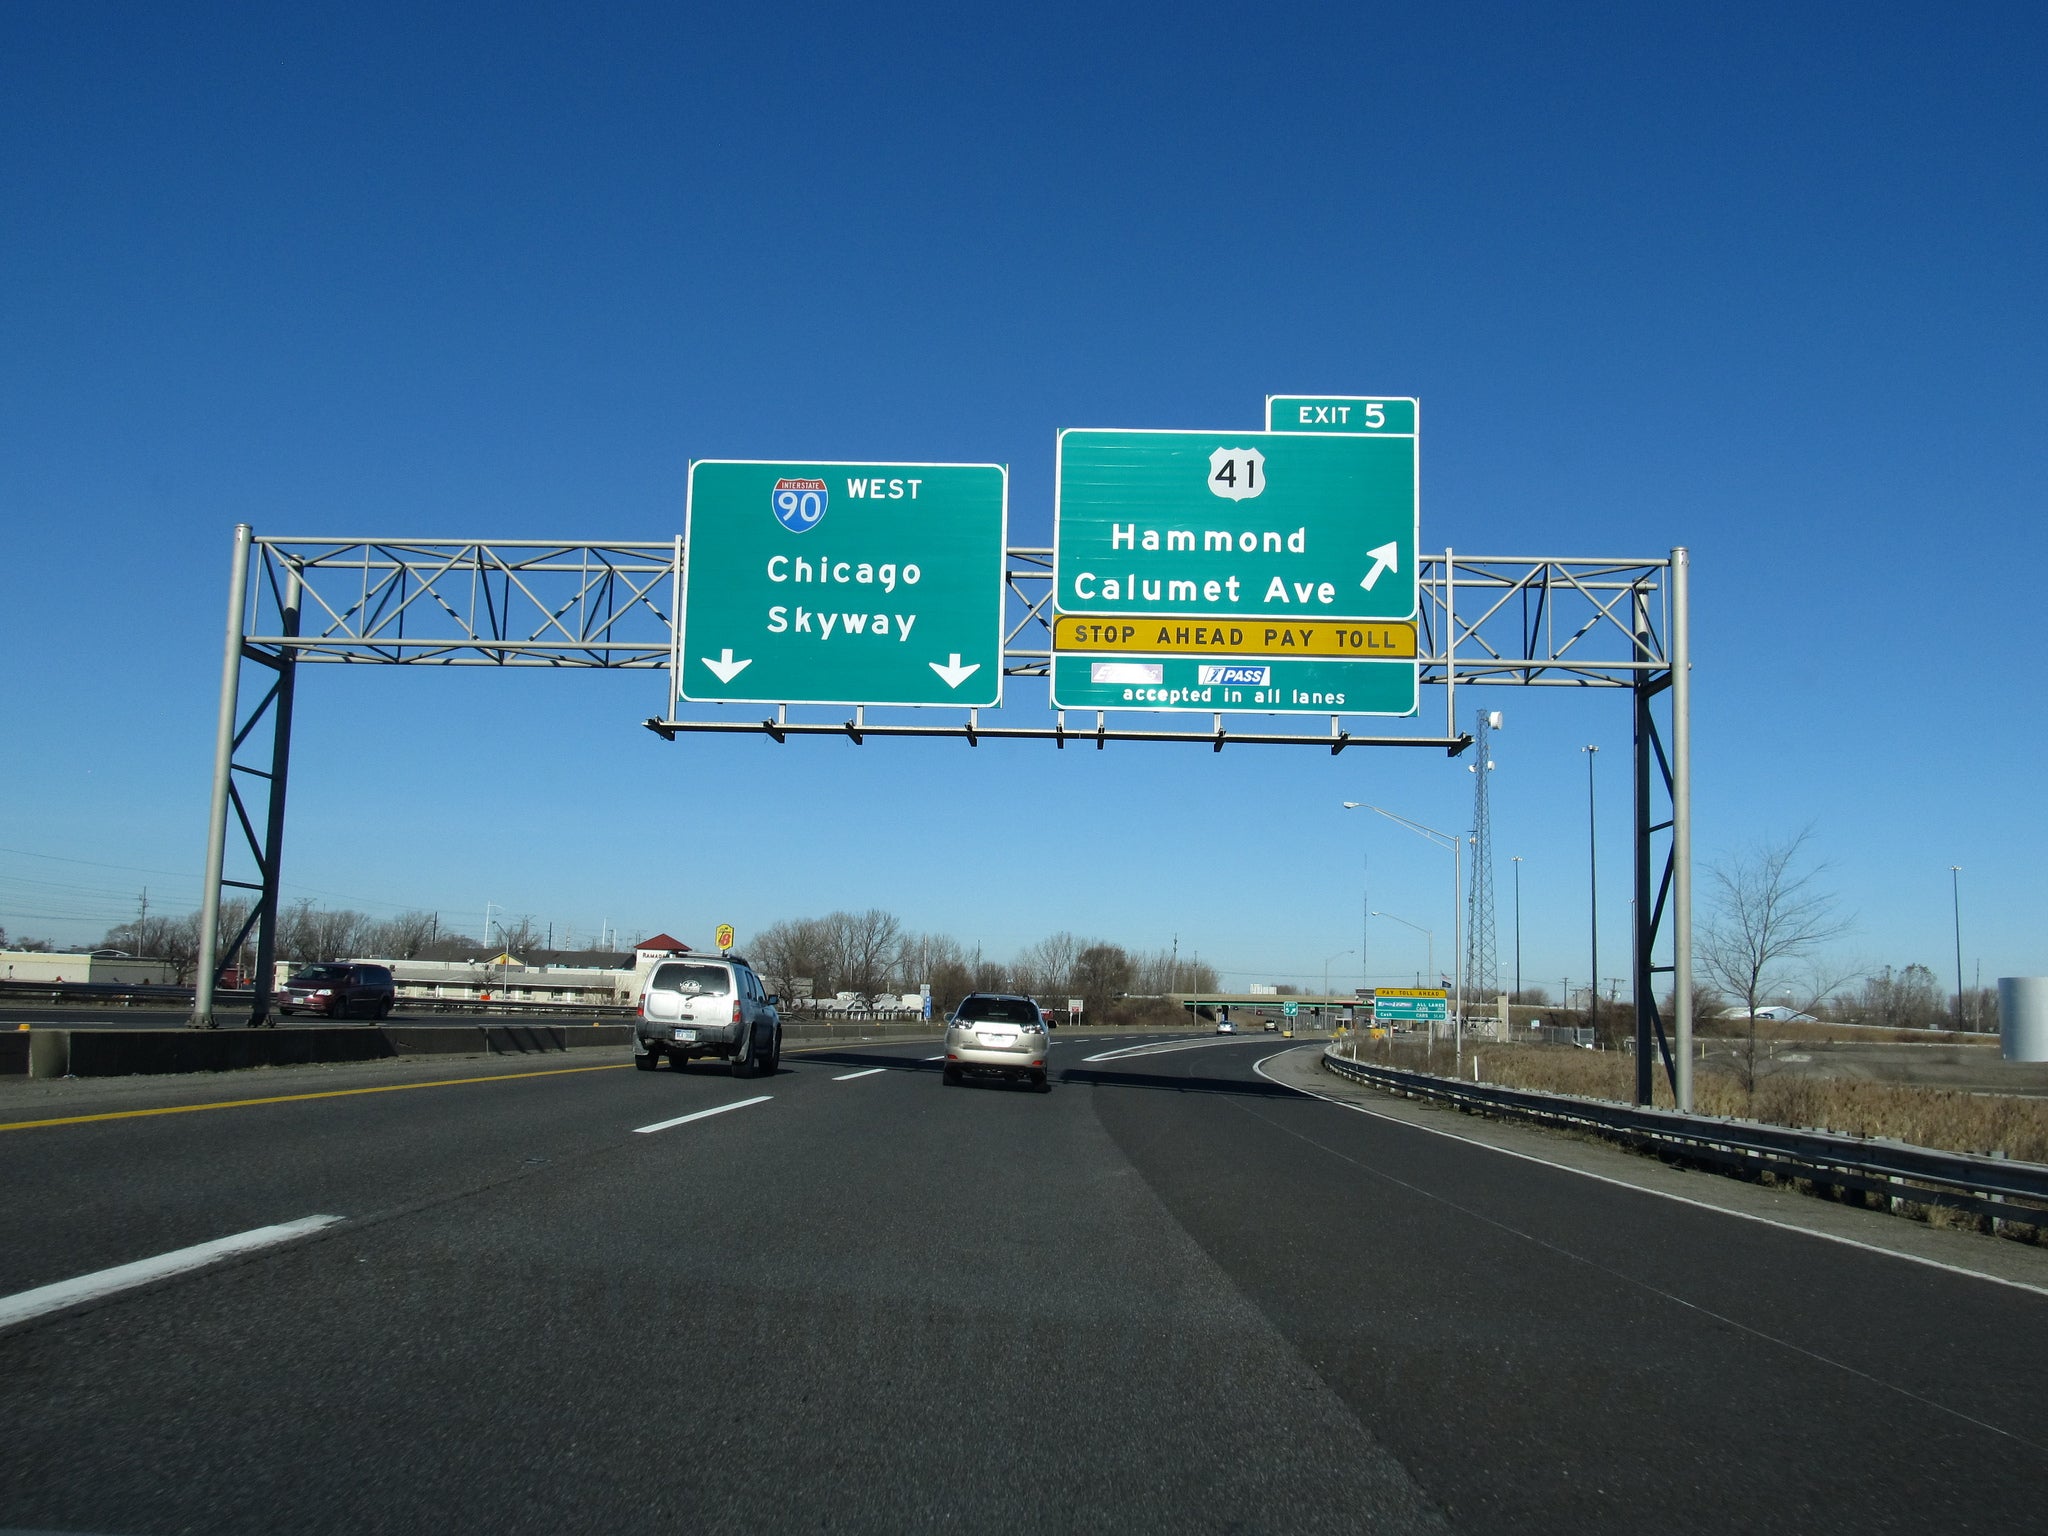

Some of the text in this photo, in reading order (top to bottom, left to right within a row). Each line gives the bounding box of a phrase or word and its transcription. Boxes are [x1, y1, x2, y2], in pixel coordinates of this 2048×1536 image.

[1299, 403, 1386, 429] EXIT 5
[781, 480, 820, 490] INTERSTATE
[847, 478, 923, 500] WEST
[1214, 459, 1255, 489] 41
[777, 492, 821, 522] 90
[1112, 523, 1305, 553] Hammond
[767, 555, 921, 594] Chicago
[1074, 572, 1336, 604] Calumet Ave
[767, 605, 916, 642] Skyway
[1075, 624, 1396, 649] STOP AHEAD PAY TOLL
[1122, 687, 1345, 705] accepted in all lanes
